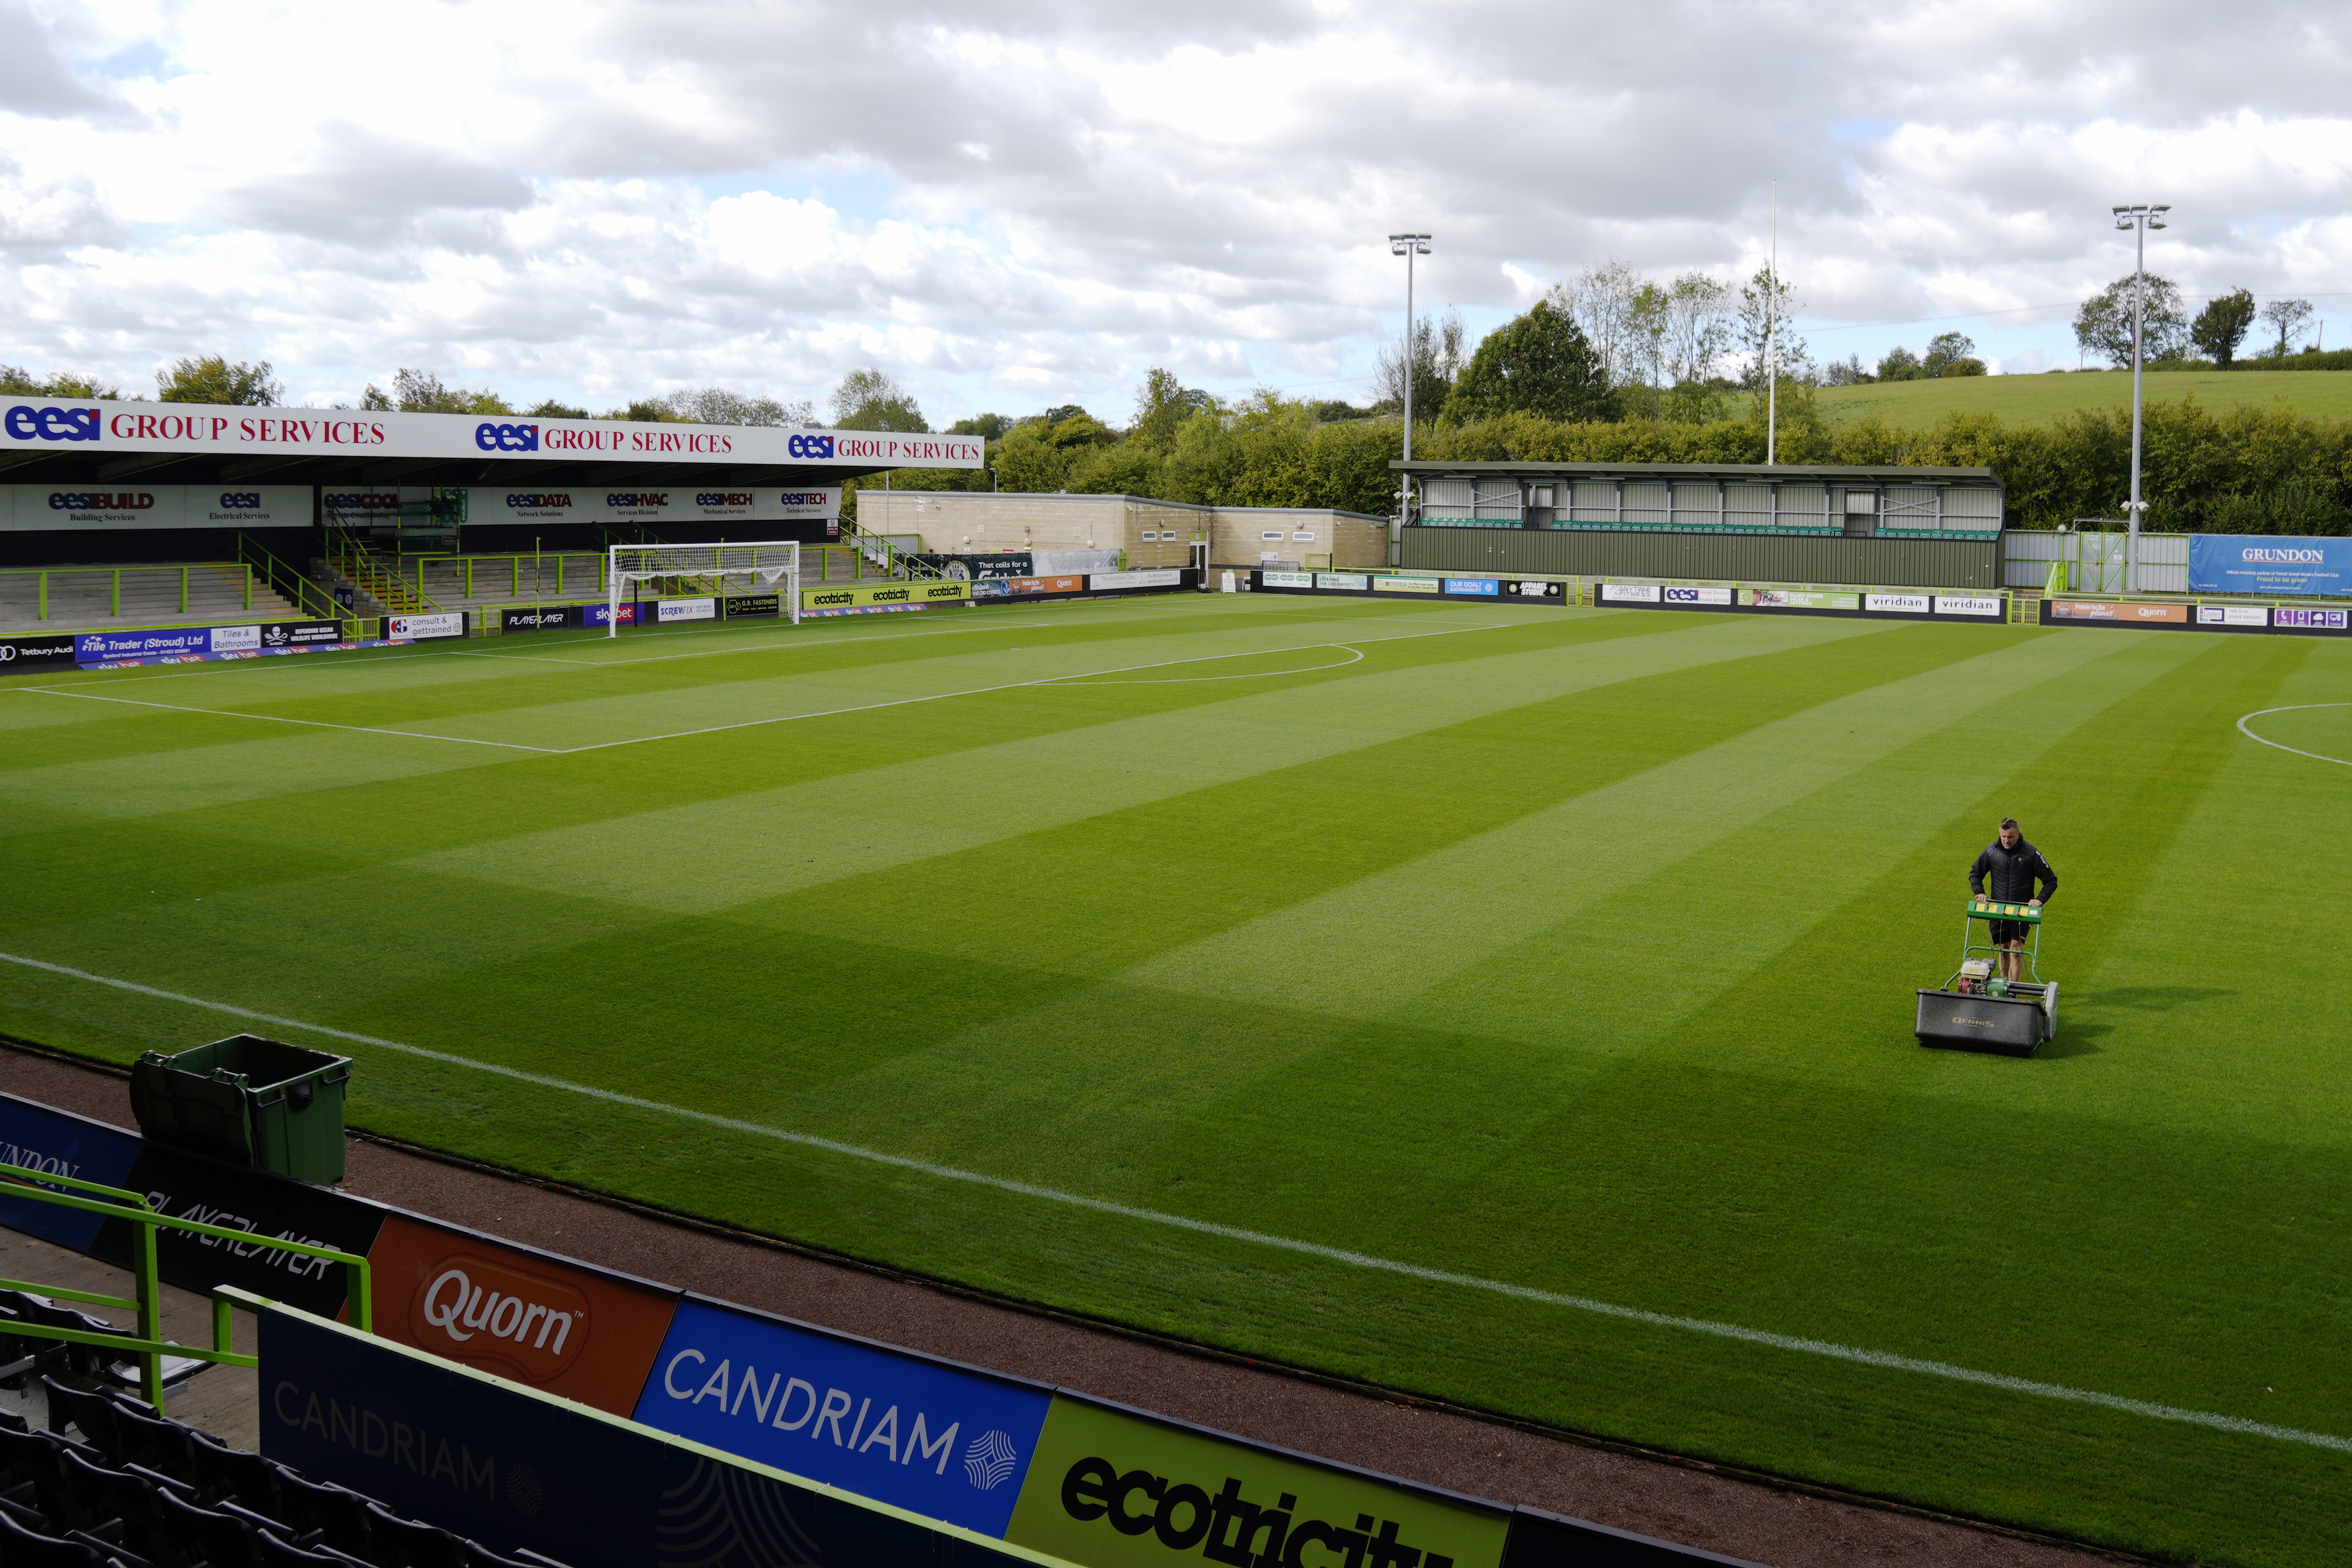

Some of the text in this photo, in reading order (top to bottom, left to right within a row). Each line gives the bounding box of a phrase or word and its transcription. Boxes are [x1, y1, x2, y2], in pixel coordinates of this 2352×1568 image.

[5, 405, 384, 445] eesi GROUP SERVICES
[476, 423, 731, 454] eesi GROUP SERVICES
[788, 434, 979, 460] eesi GROUP SERVICES
[220, 493, 260, 508] eesi
[70, 513, 102, 522] Building
[2242, 548, 2324, 562] GRUNDON
[1057, 580, 1072, 588] Quorn
[1520, 582, 1548, 590] APPAREL
[873, 588, 910, 601] ecotricity
[927, 585, 962, 597] ecotricity
[1666, 589, 1698, 601] eesi
[814, 592, 854, 605] ecotricity
[1873, 596, 1921, 607] viridian
[1943, 599, 1992, 609] viridian
[616, 607, 632, 618] bet
[660, 605, 694, 616] SCREWFIX
[2090, 607, 2113, 618] planet
[2138, 608, 2167, 617] Quorn
[412, 617, 439, 625] consult
[222, 630, 241, 638] Tiles
[412, 625, 451, 636] gettrained
[86, 636, 203, 652] Tile Trader (Stroud) Ltd
[214, 639, 258, 649] Bathrooms
[19, 646, 73, 656] Tetbury Audi
[1952, 1016, 1995, 1028] DENNIS
[665, 1349, 960, 1476] CANDRIAM
[274, 1380, 495, 1502] CANDRIAM
[1061, 1456, 1454, 1568] ecotricit
